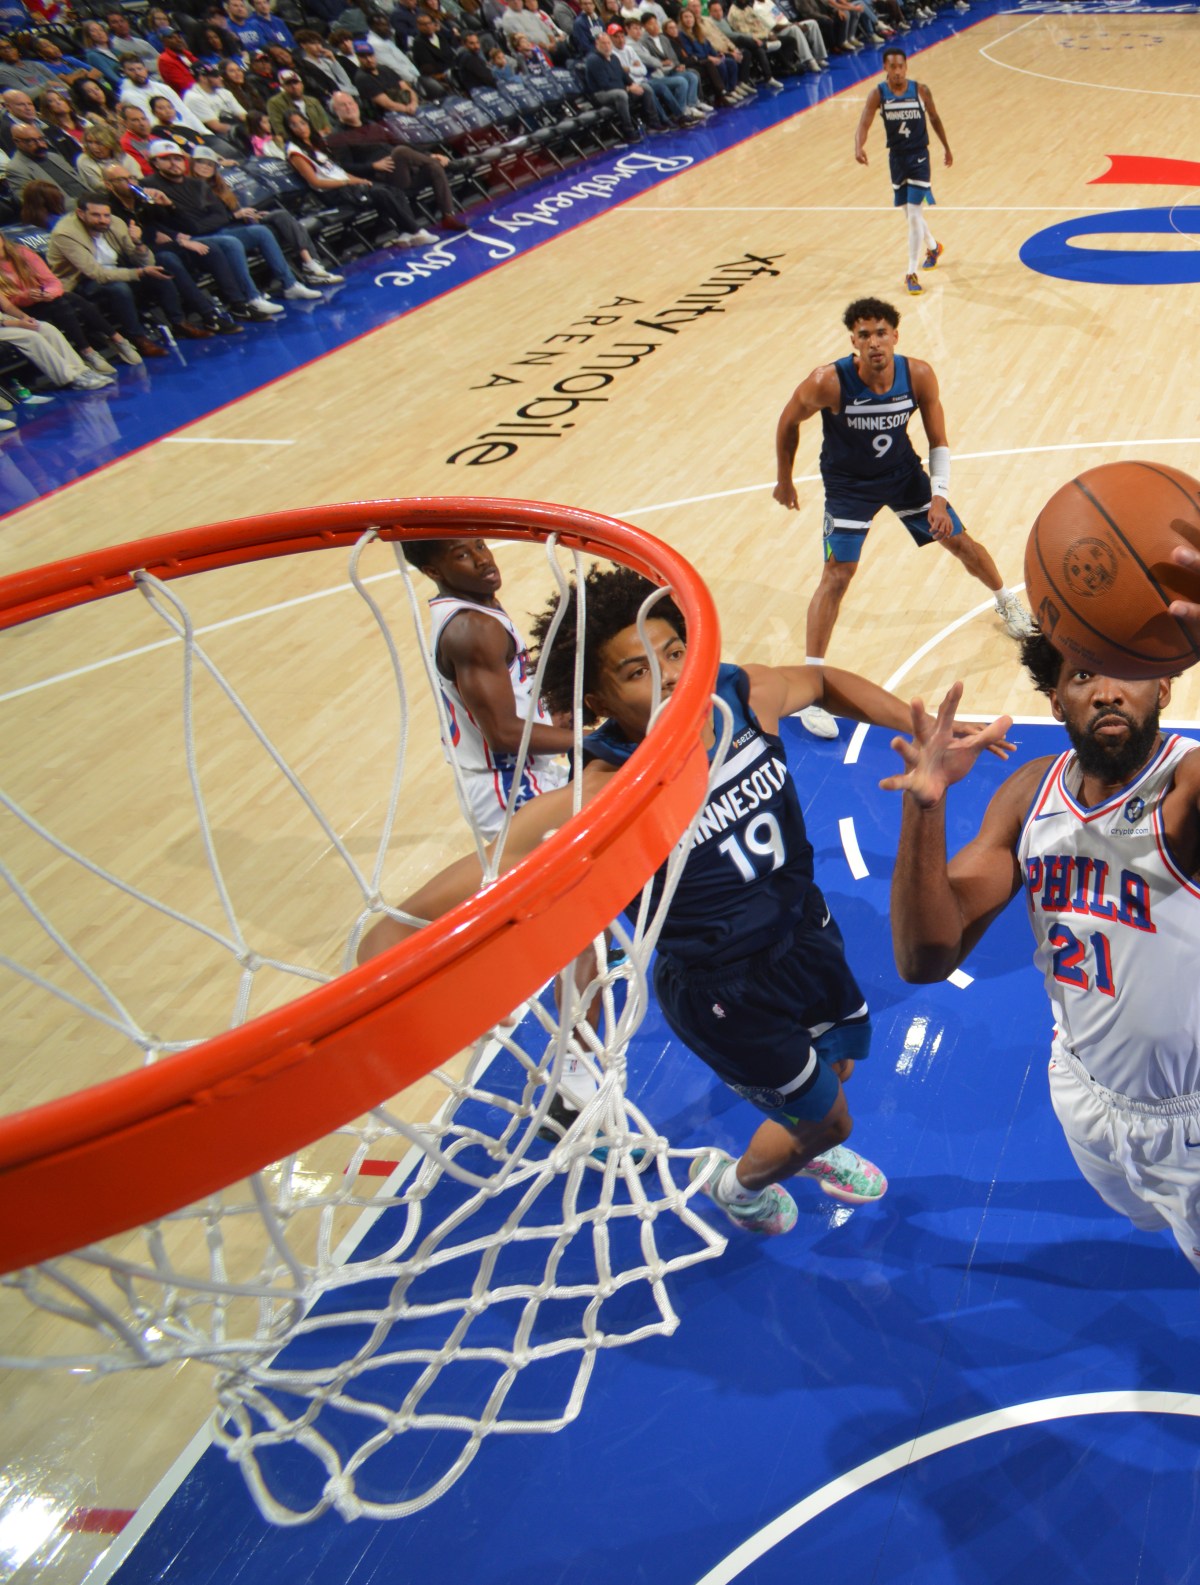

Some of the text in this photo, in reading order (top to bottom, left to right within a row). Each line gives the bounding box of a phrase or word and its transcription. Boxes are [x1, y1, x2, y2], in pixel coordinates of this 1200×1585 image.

[885, 109, 921, 121] MINNESOTA
[898, 121, 911, 139] 4
[374, 152, 694, 288] Brotherly Love
[468, 295, 646, 391] ARENA
[445, 342, 663, 467] mobile
[846, 410, 910, 431] MINNESOTA
[872, 433, 893, 459] 9
[717, 812, 787, 884] 19
[1110, 827, 1149, 836] crypto.com
[1026, 854, 1157, 934] PHILA
[1047, 921, 1116, 998] 21
